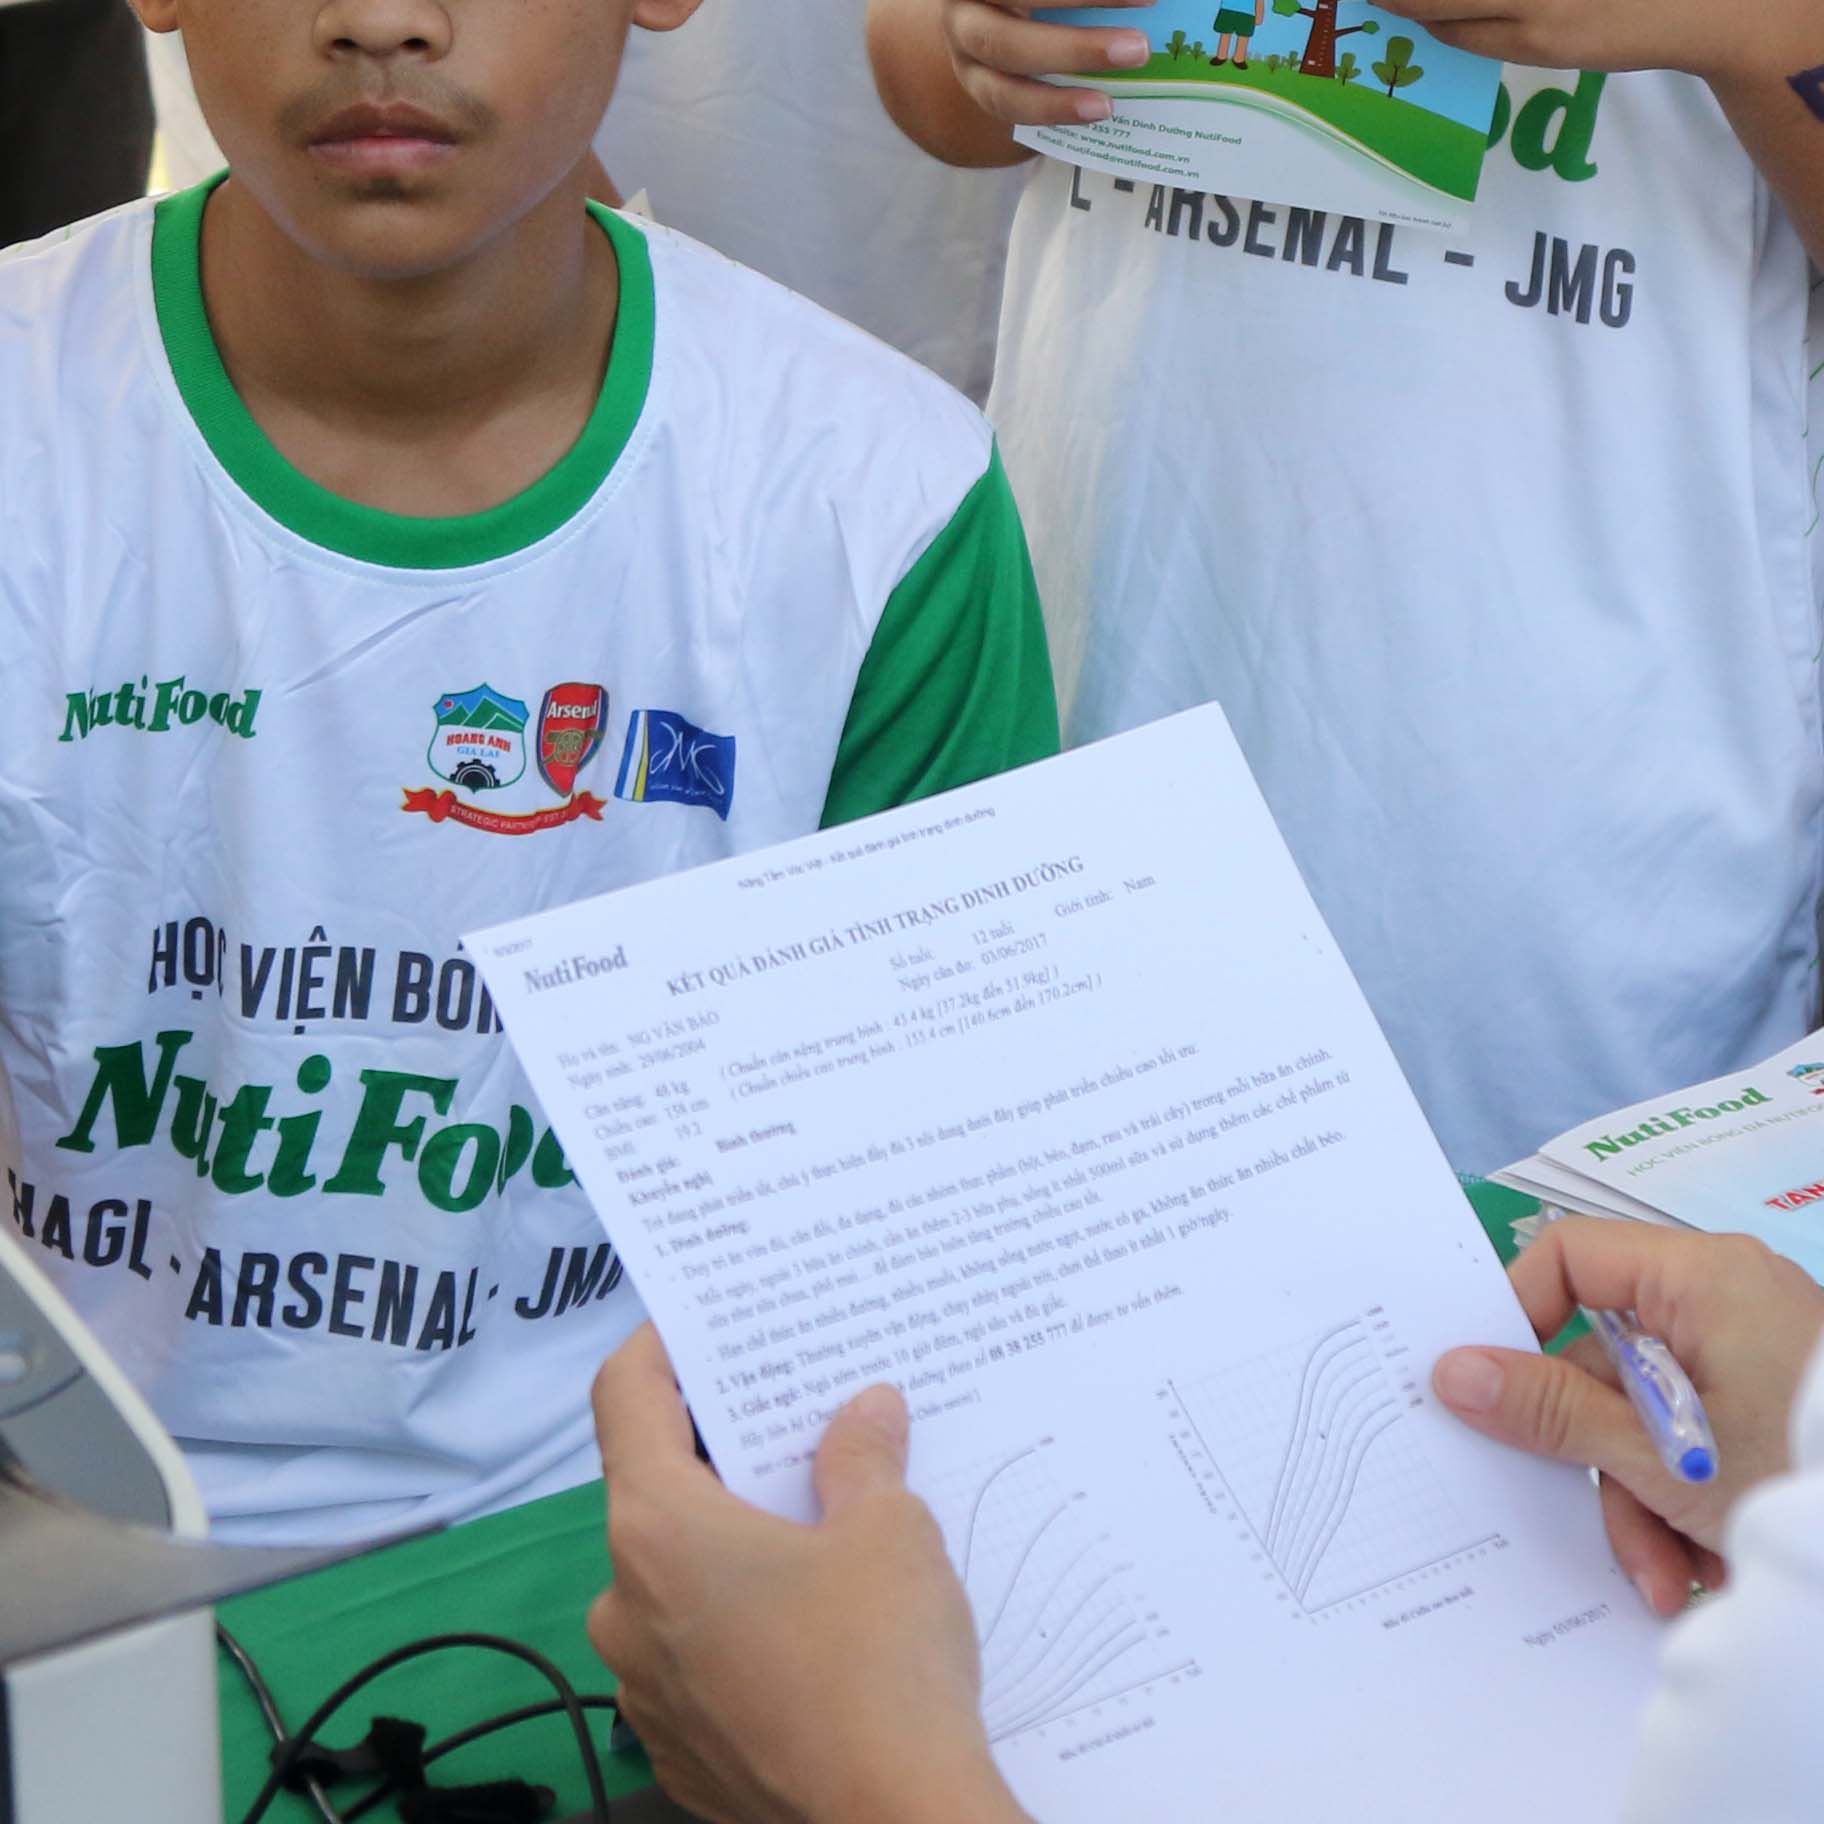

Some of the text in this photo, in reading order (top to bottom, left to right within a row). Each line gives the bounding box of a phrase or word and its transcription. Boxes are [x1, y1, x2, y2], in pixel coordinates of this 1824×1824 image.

[1066, 141, 1200, 179] nutifood@nutifood.com.vn
[1080, 134, 1190, 164] www.nutifood.com.vn
[1132, 119, 1156, 132] Dinh
[1194, 130, 1242, 146] NutiFood
[1504, 229, 1637, 329] JMG
[58, 673, 263, 743] NutiFood
[808, 929, 841, 952] GIÁ
[894, 894, 957, 926] TRẠNG
[961, 879, 1007, 905] DINH
[1012, 855, 1083, 889] DƯỠNG
[1124, 873, 1153, 891] Nam
[240, 925, 377, 1035] VIỆN
[522, 945, 629, 996] NutiFood
[1584, 1087, 1774, 1163] NutiFood
[185, 1245, 483, 1353] ARSENAL
